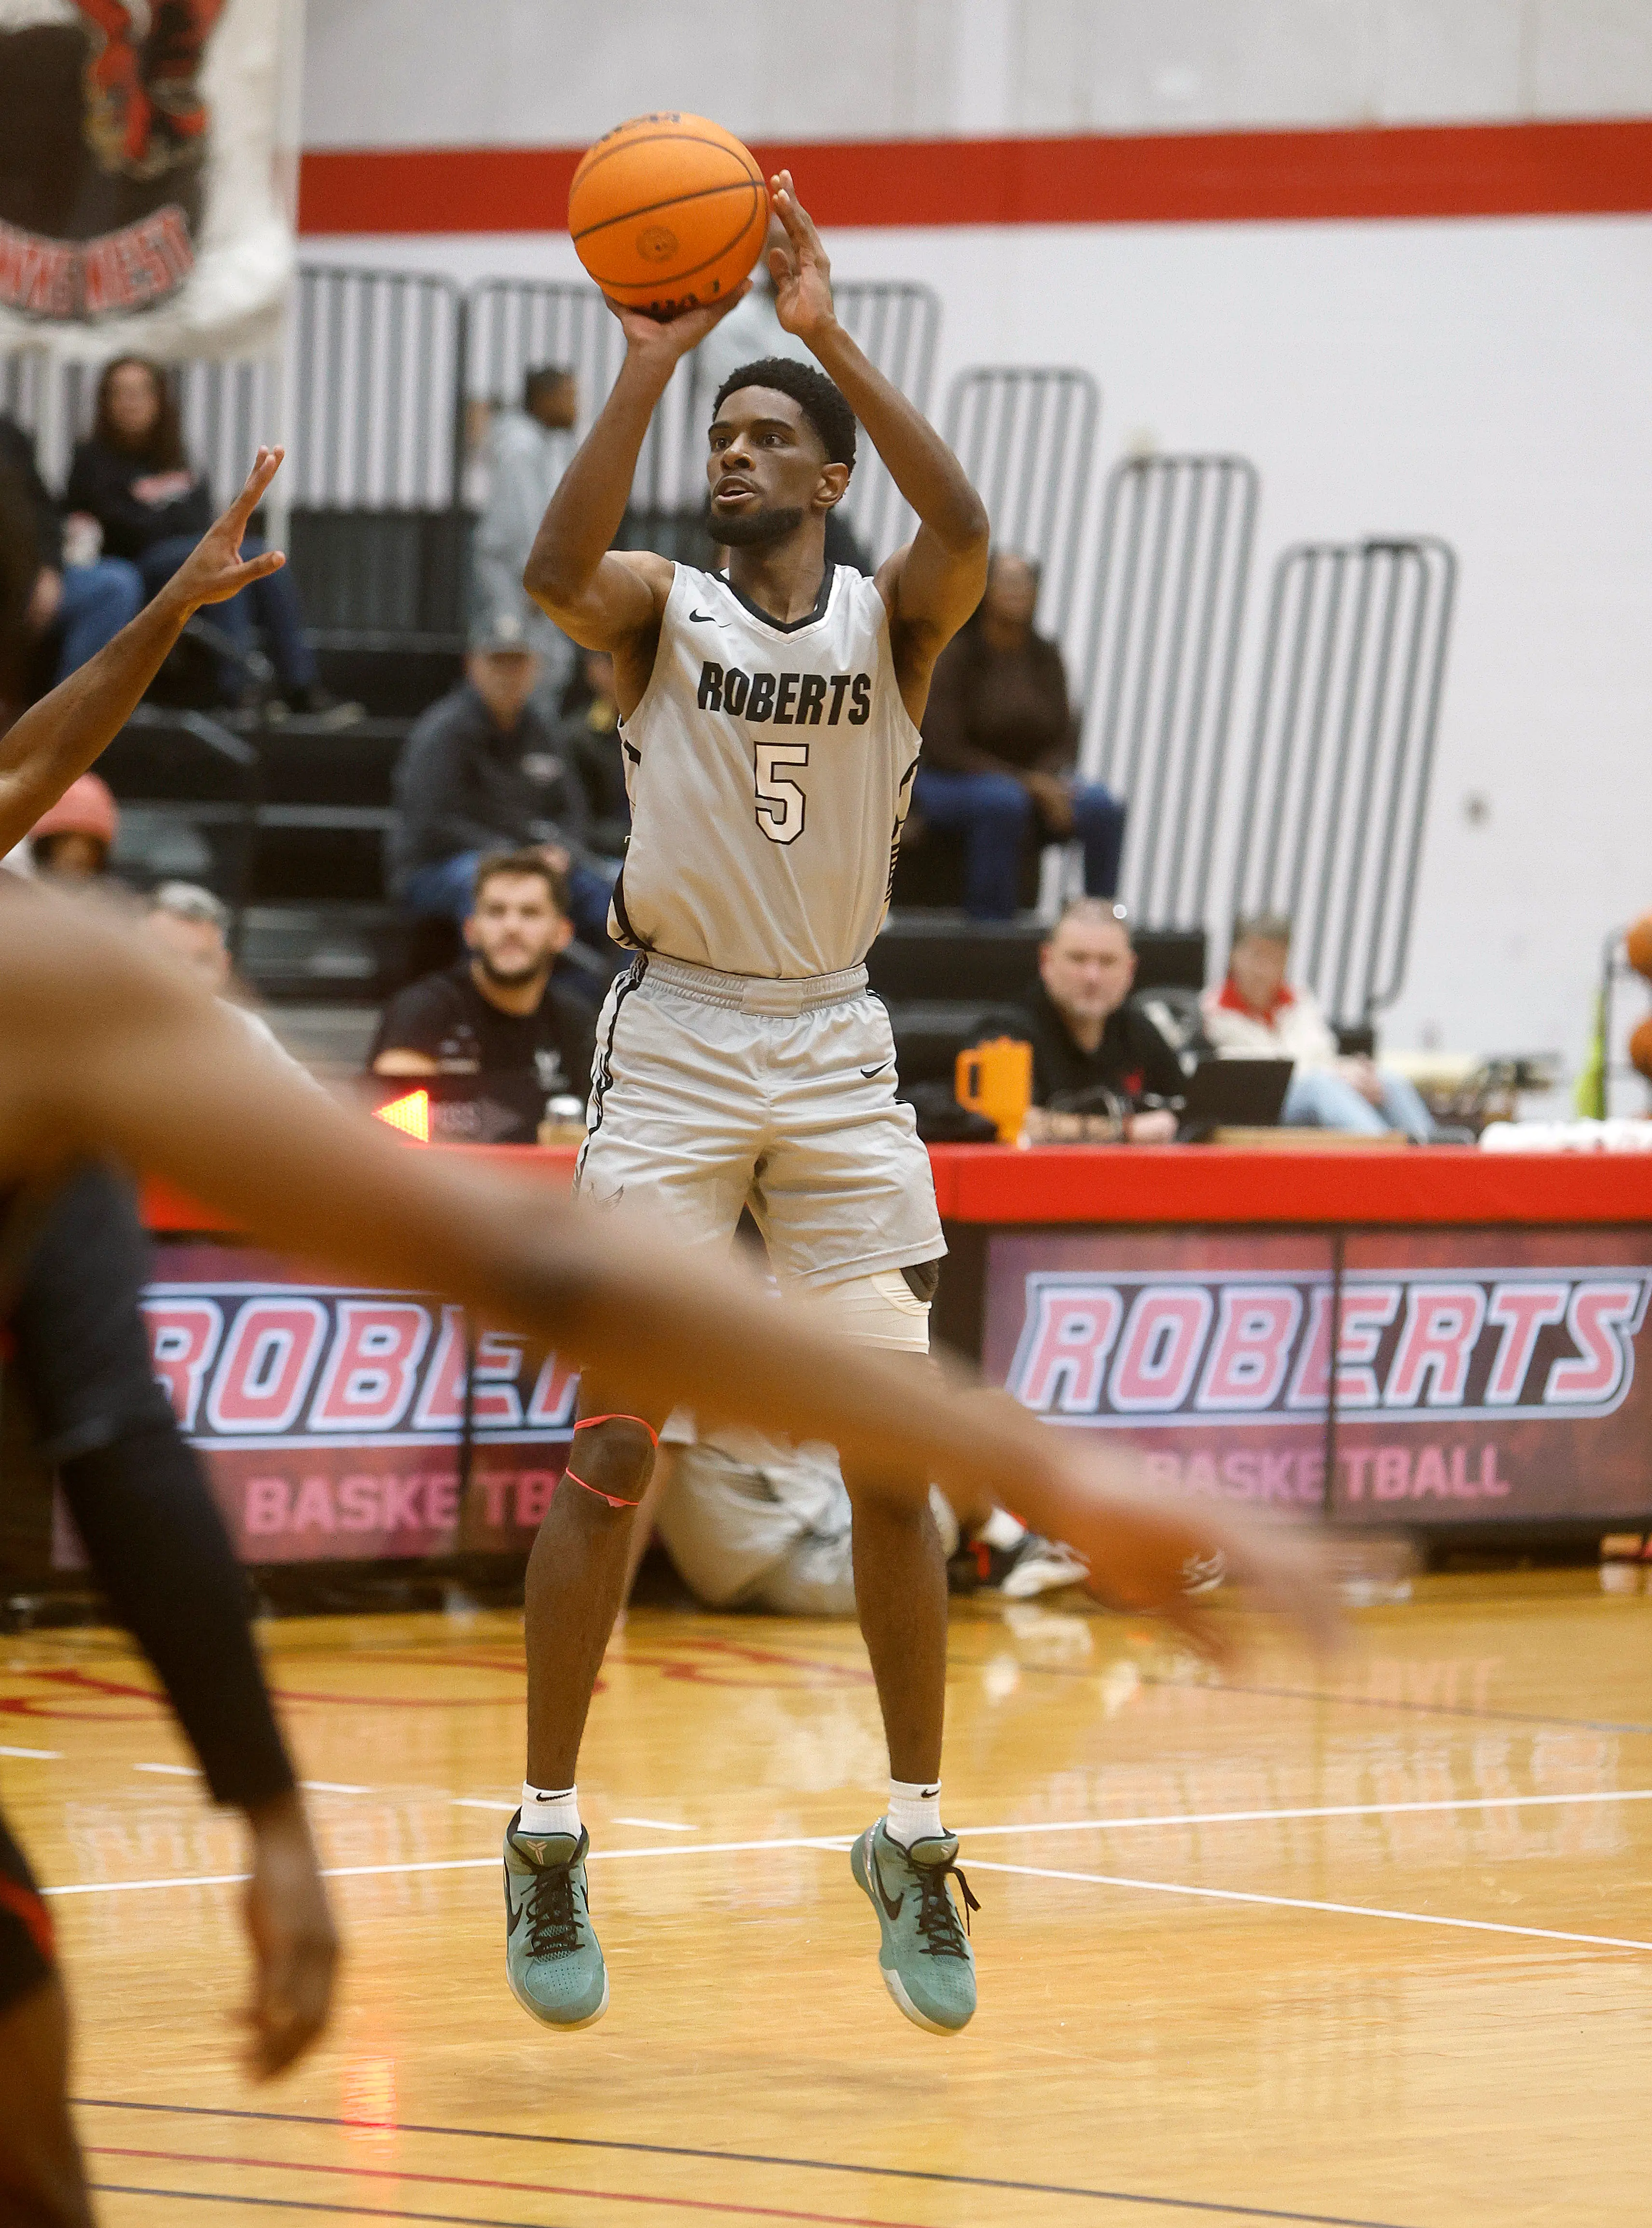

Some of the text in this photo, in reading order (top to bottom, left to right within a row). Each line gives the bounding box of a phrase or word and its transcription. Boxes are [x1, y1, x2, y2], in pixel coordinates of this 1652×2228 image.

[698, 660, 871, 725] ROBERTS
[754, 742, 810, 845] 5
[138, 1297, 581, 1433] ROBE
[1020, 1283, 1641, 1414] ROBERTS
[244, 1471, 557, 1535] BASKETB
[1150, 1445, 1510, 1499] BASKETBALL
